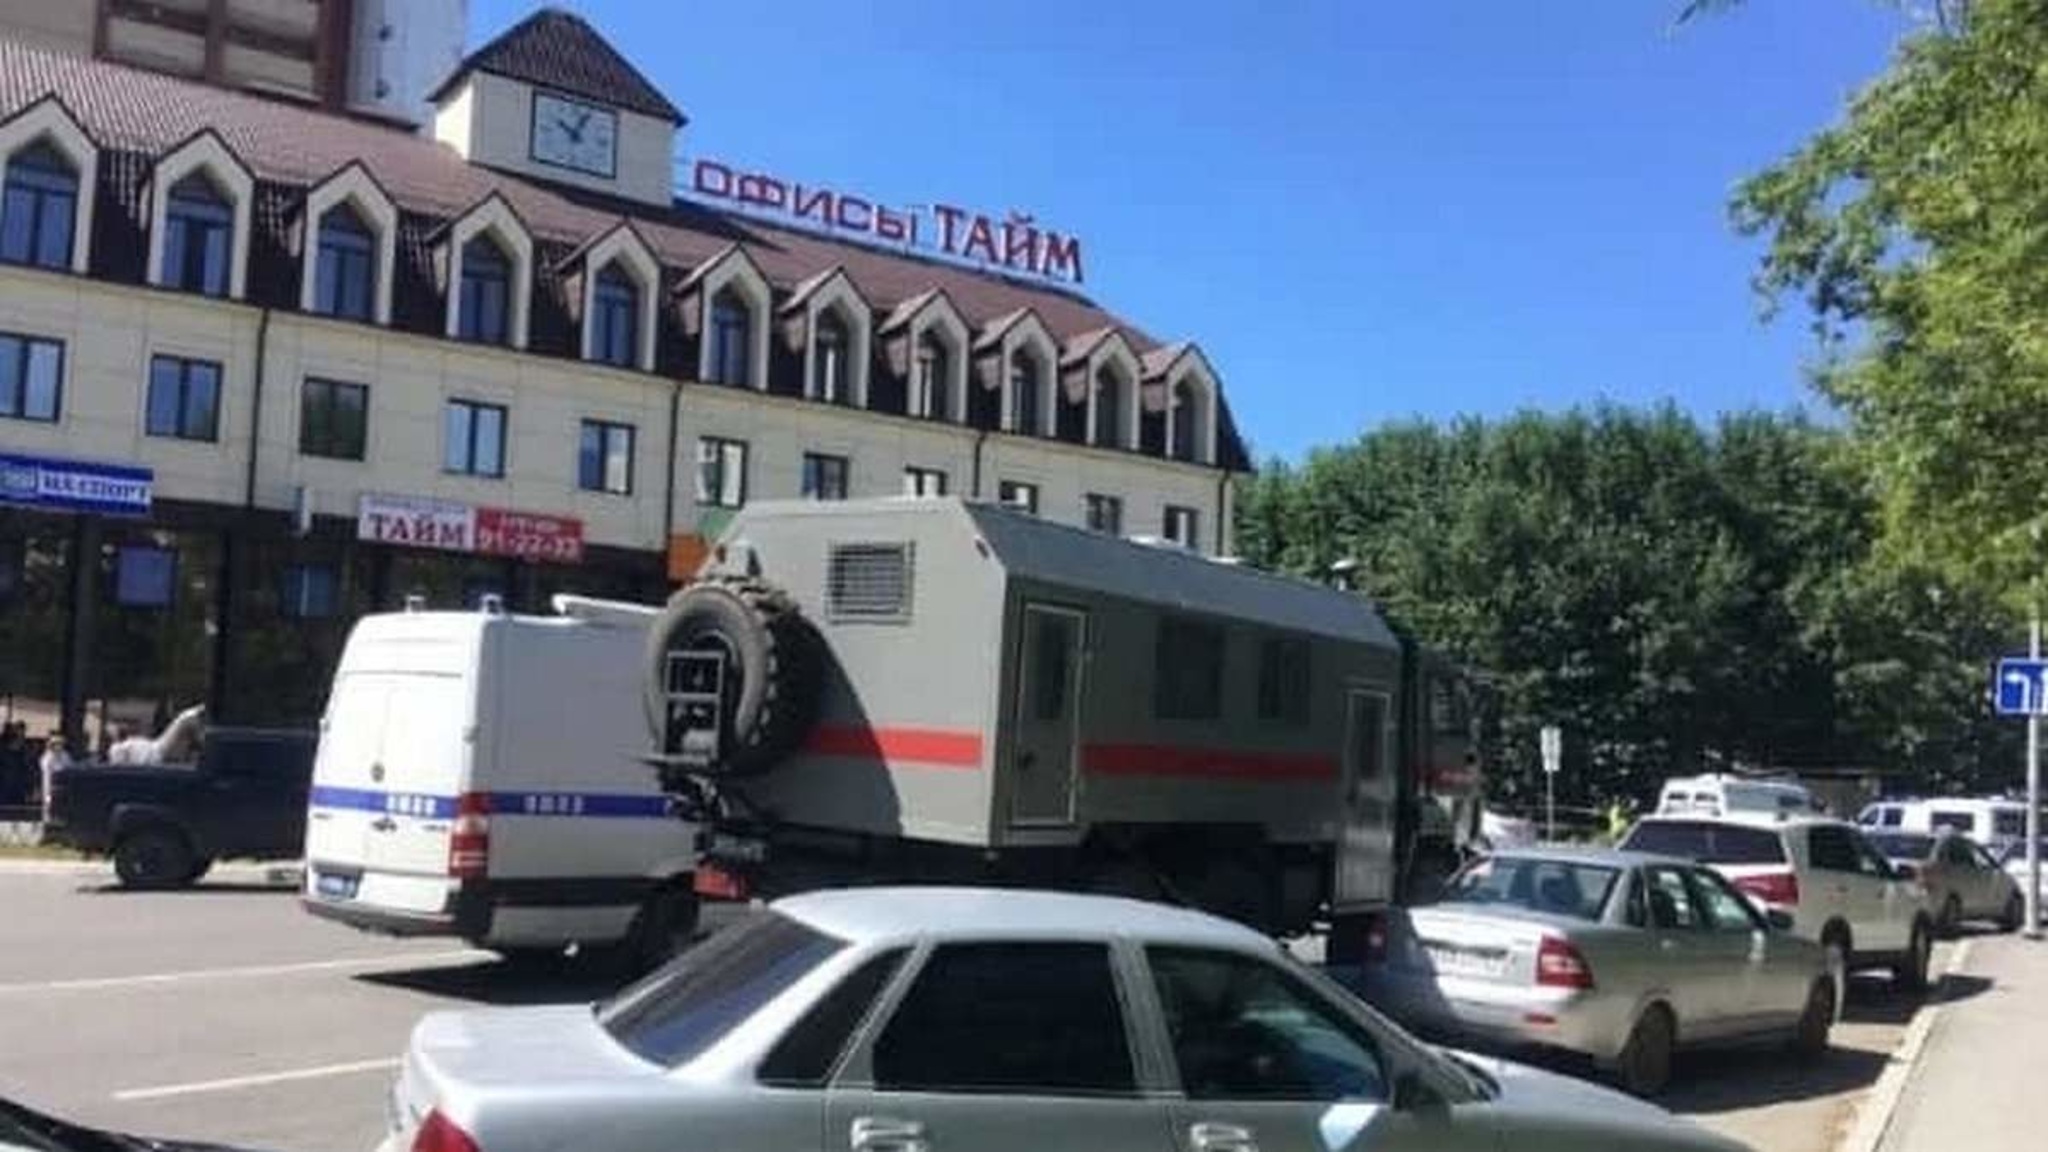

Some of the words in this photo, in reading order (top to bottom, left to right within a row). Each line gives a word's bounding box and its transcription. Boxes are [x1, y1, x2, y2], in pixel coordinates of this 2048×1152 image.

[692, 159, 917, 244] ОФИСЫ
[934, 203, 1084, 282] ТАЙМ
[368, 512, 465, 547] ТАЙМ
